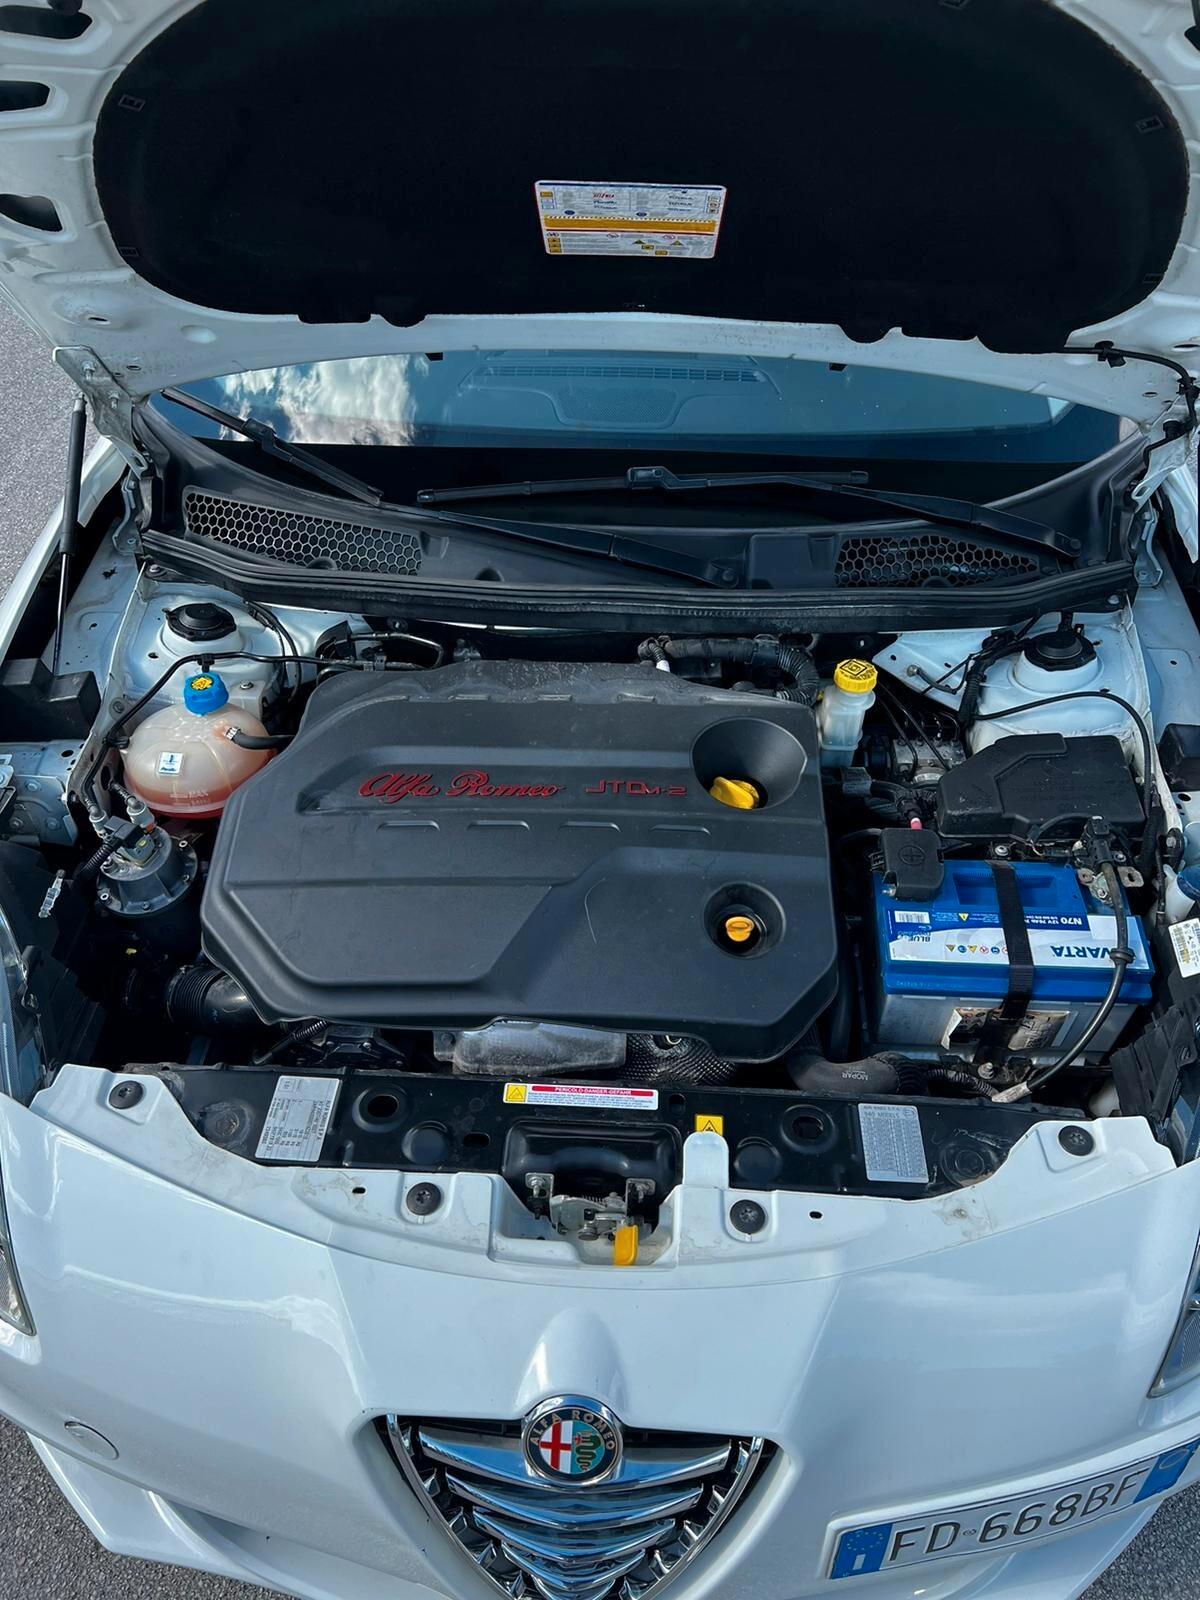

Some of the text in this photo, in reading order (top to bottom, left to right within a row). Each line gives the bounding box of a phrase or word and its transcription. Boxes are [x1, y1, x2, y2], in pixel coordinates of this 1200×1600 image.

[358, 769, 566, 804] Alfa Romeo
[1060, 917, 1082, 925] N70
[1050, 945, 1112, 959] VARTA
[841, 1071, 869, 1081] MOPAR
[530, 1412, 562, 1446] ALFA
[571, 1409, 616, 1450] ROMEO
[889, 1467, 1150, 1561] FD 668BF
